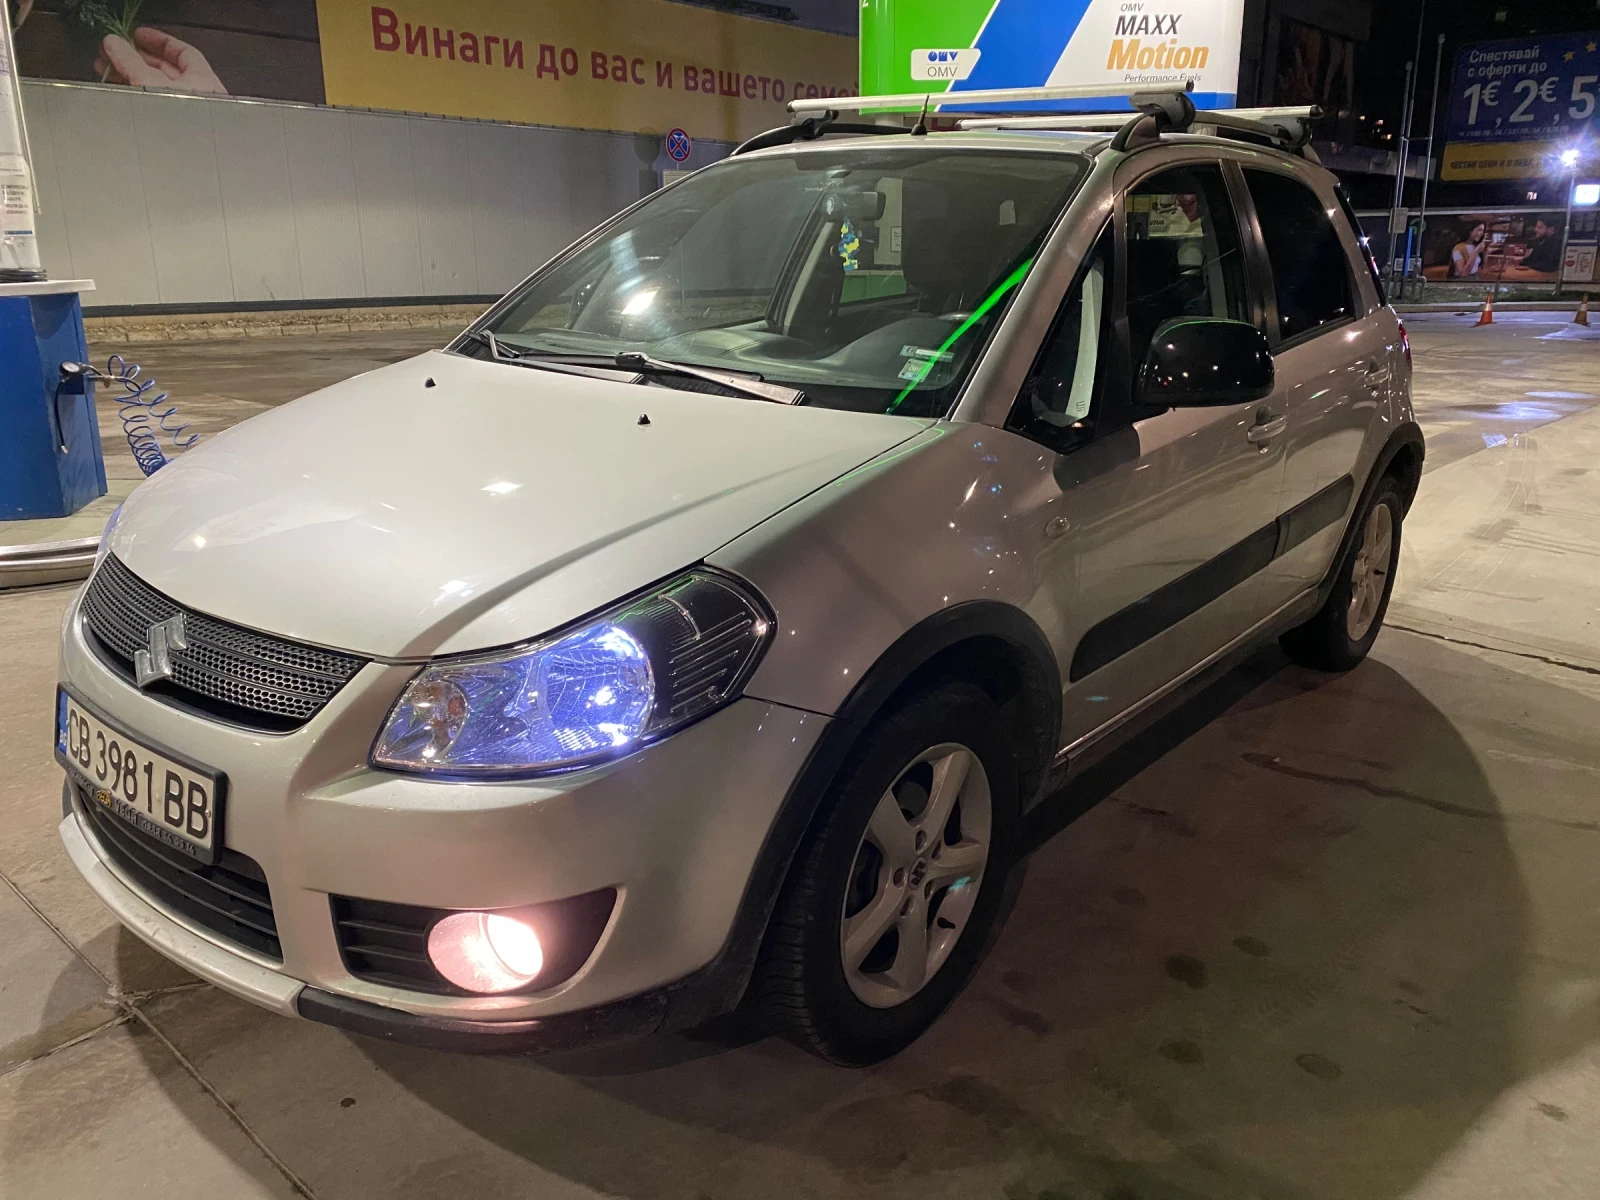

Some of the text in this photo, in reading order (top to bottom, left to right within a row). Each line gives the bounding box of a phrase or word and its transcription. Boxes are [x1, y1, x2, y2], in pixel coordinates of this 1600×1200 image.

[1120, 3, 1144, 12] OMV
[1115, 14, 1182, 35] MAXX
[371, 6, 525, 70] Винаги
[536, 45, 579, 81] до
[591, 51, 645, 85] вас
[656, 60, 673, 89] и
[684, 64, 785, 102] вашето
[1106, 38, 1209, 70] Motion
[1469, 45, 1540, 63] Спестявай
[927, 66, 958, 77] OMV
[1124, 73, 1202, 82] Performance Fuels
[1467, 62, 1547, 79] с оферти до
[69, 708, 91, 769] CB
[95, 730, 154, 814] 3981
[163, 769, 209, 840] BB
